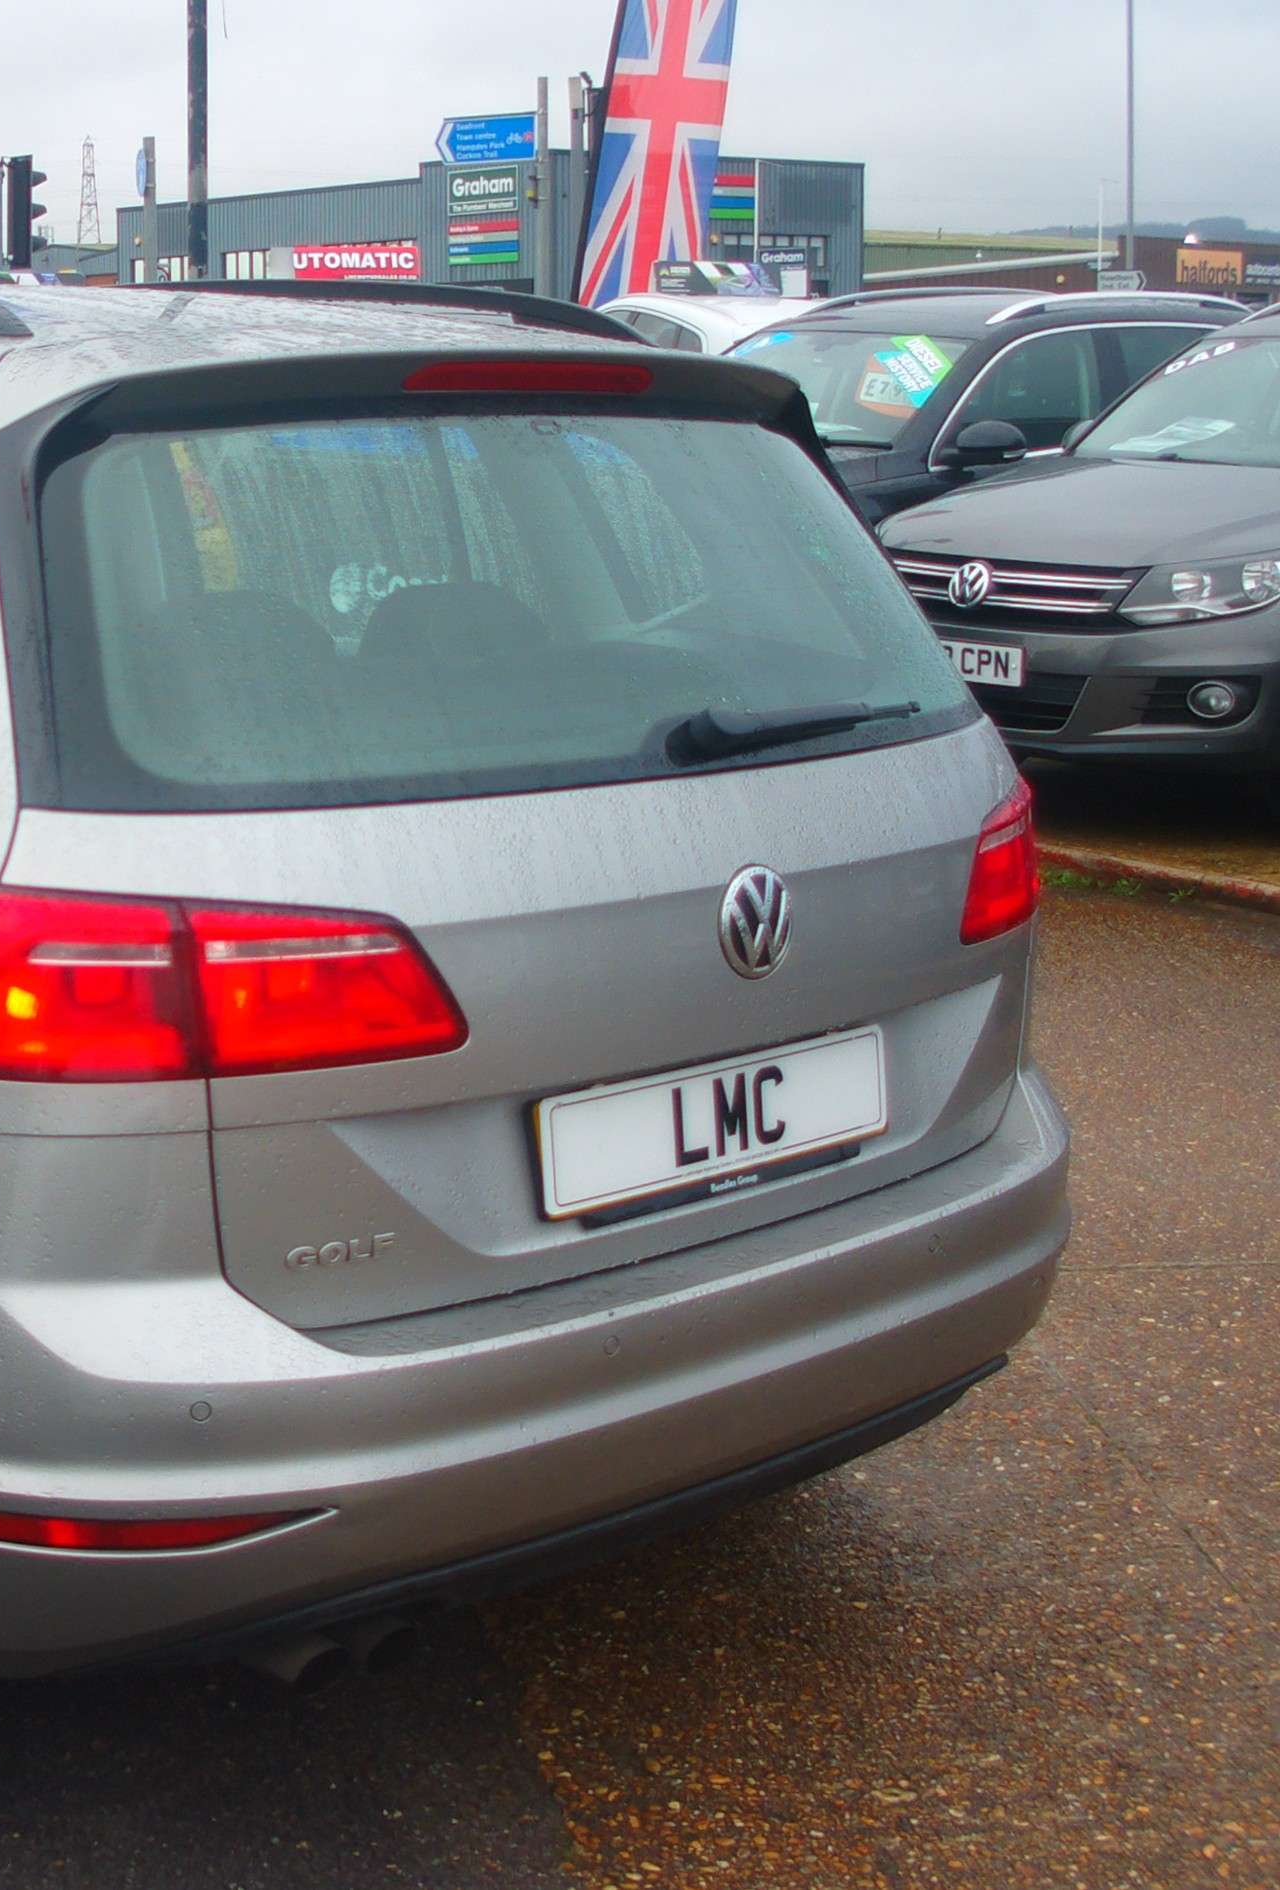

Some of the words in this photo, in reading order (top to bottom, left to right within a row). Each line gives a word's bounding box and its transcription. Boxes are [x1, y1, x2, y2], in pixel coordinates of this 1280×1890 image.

[452, 176, 513, 197] Graham
[761, 252, 804, 263] Graham
[1181, 260, 1237, 285] halfords
[1164, 342, 1235, 375] DAB
[961, 648, 1009, 679] CPN
[671, 1066, 786, 1167] LMC
[284, 1232, 396, 1271] GOLF
